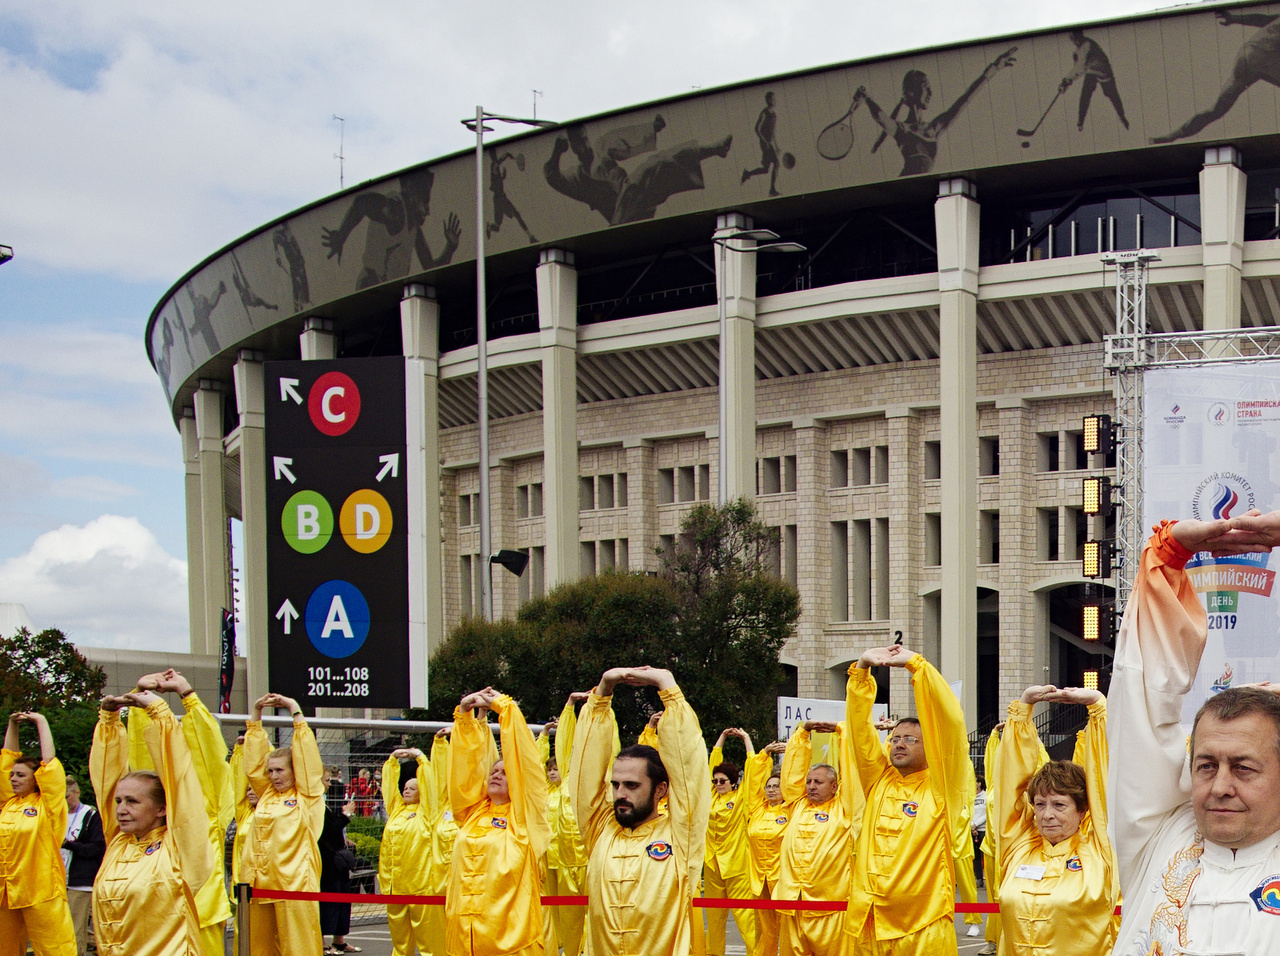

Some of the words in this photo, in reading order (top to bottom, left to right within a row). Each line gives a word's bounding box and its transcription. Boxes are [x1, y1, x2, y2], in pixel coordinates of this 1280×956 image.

[321, 386, 346, 423] C
[1236, 410, 1262, 418] СТРАНА
[1192, 472, 1220, 521] ЛИМПИЙСКИЙ
[1221, 471, 1252, 492] КОМИТЕТ
[1247, 492, 1256, 511] РОС
[296, 504, 321, 540] B
[355, 503, 380, 540] D
[1189, 568, 1268, 590] ИМПИЙСКИЙ
[1210, 596, 1234, 607] ДЕНЬ
[320, 595, 355, 638] A
[1207, 614, 1237, 630] 2019
[894, 630, 903, 645] 2
[307, 666, 370, 681] 101...108
[307, 682, 370, 697] 201...208
